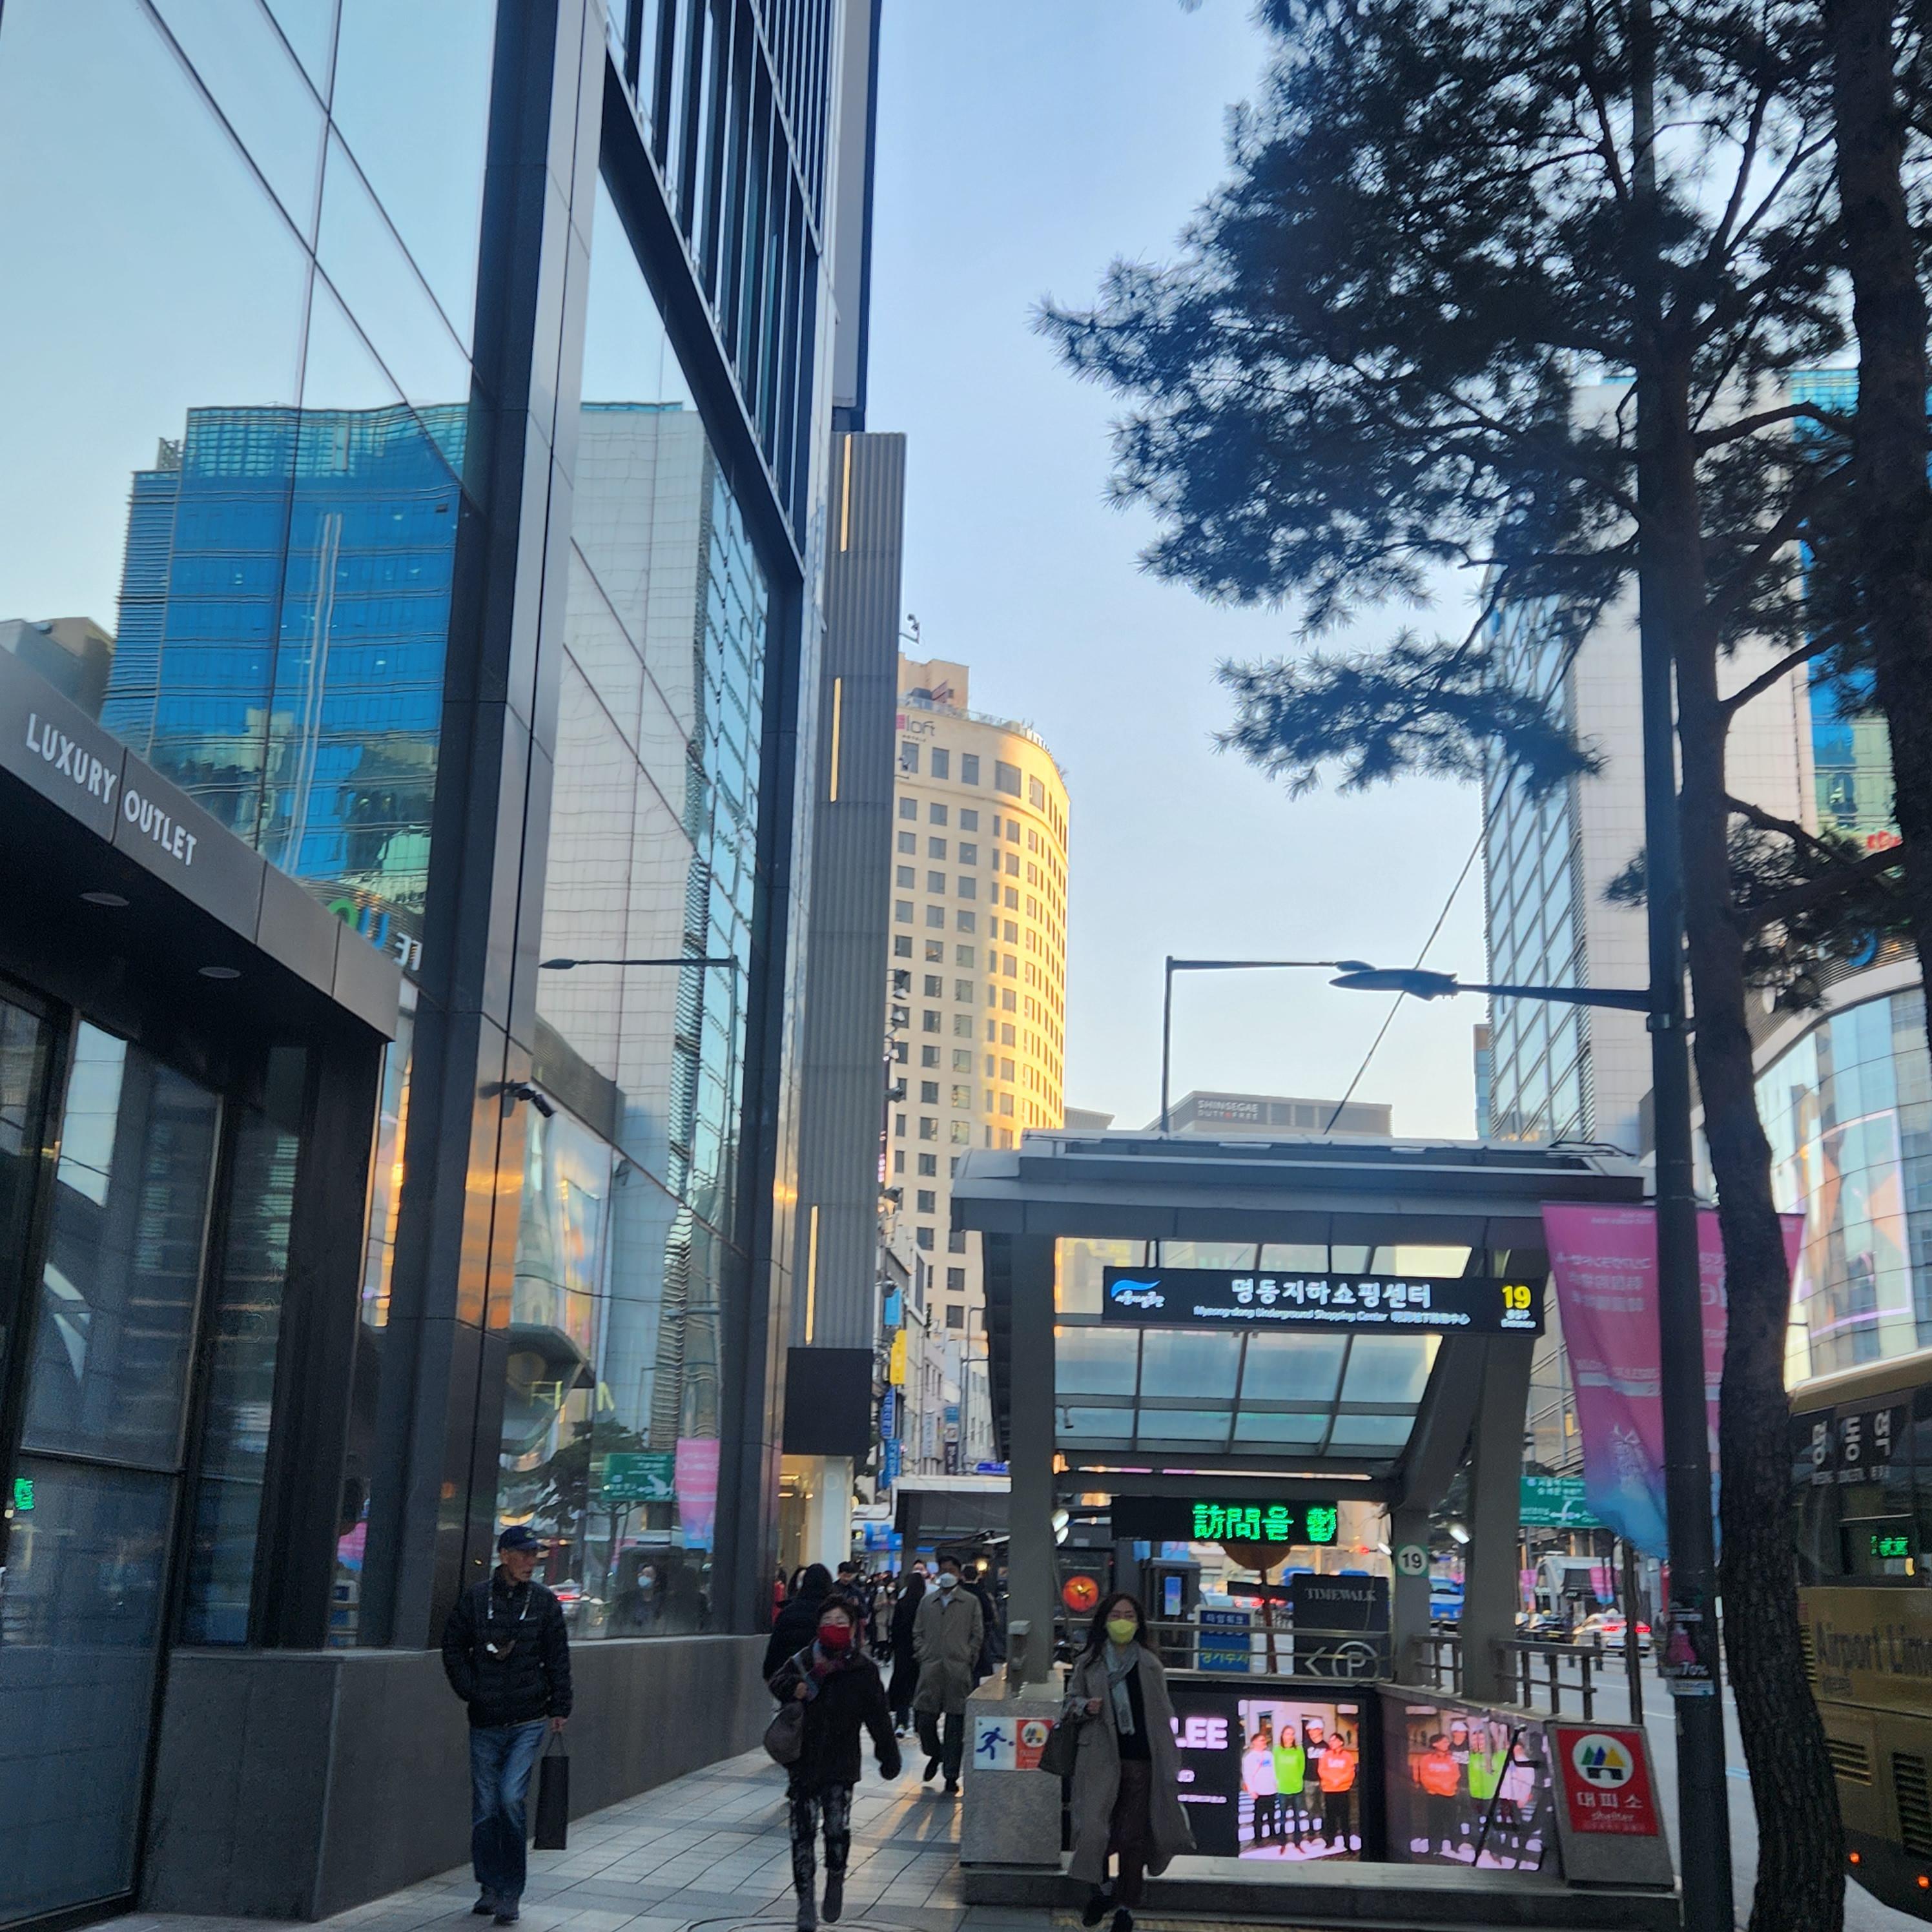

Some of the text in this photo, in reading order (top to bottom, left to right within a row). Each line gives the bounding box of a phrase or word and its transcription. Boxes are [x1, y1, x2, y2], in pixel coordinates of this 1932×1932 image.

[26, 713, 197, 866] LUXURY OUTLET
[1198, 1100, 1259, 1113] SHINSEGAE
[1231, 1277, 1432, 1310] 명동지하쇼핑센터
[1502, 1286, 1531, 1309] 19
[1192, 1504, 1294, 1541] 訪問을
[1402, 1552, 1423, 1569] 19
[1304, 1588, 1377, 1602] TIMEWALK
[1576, 1791, 1644, 1809] 대피소
